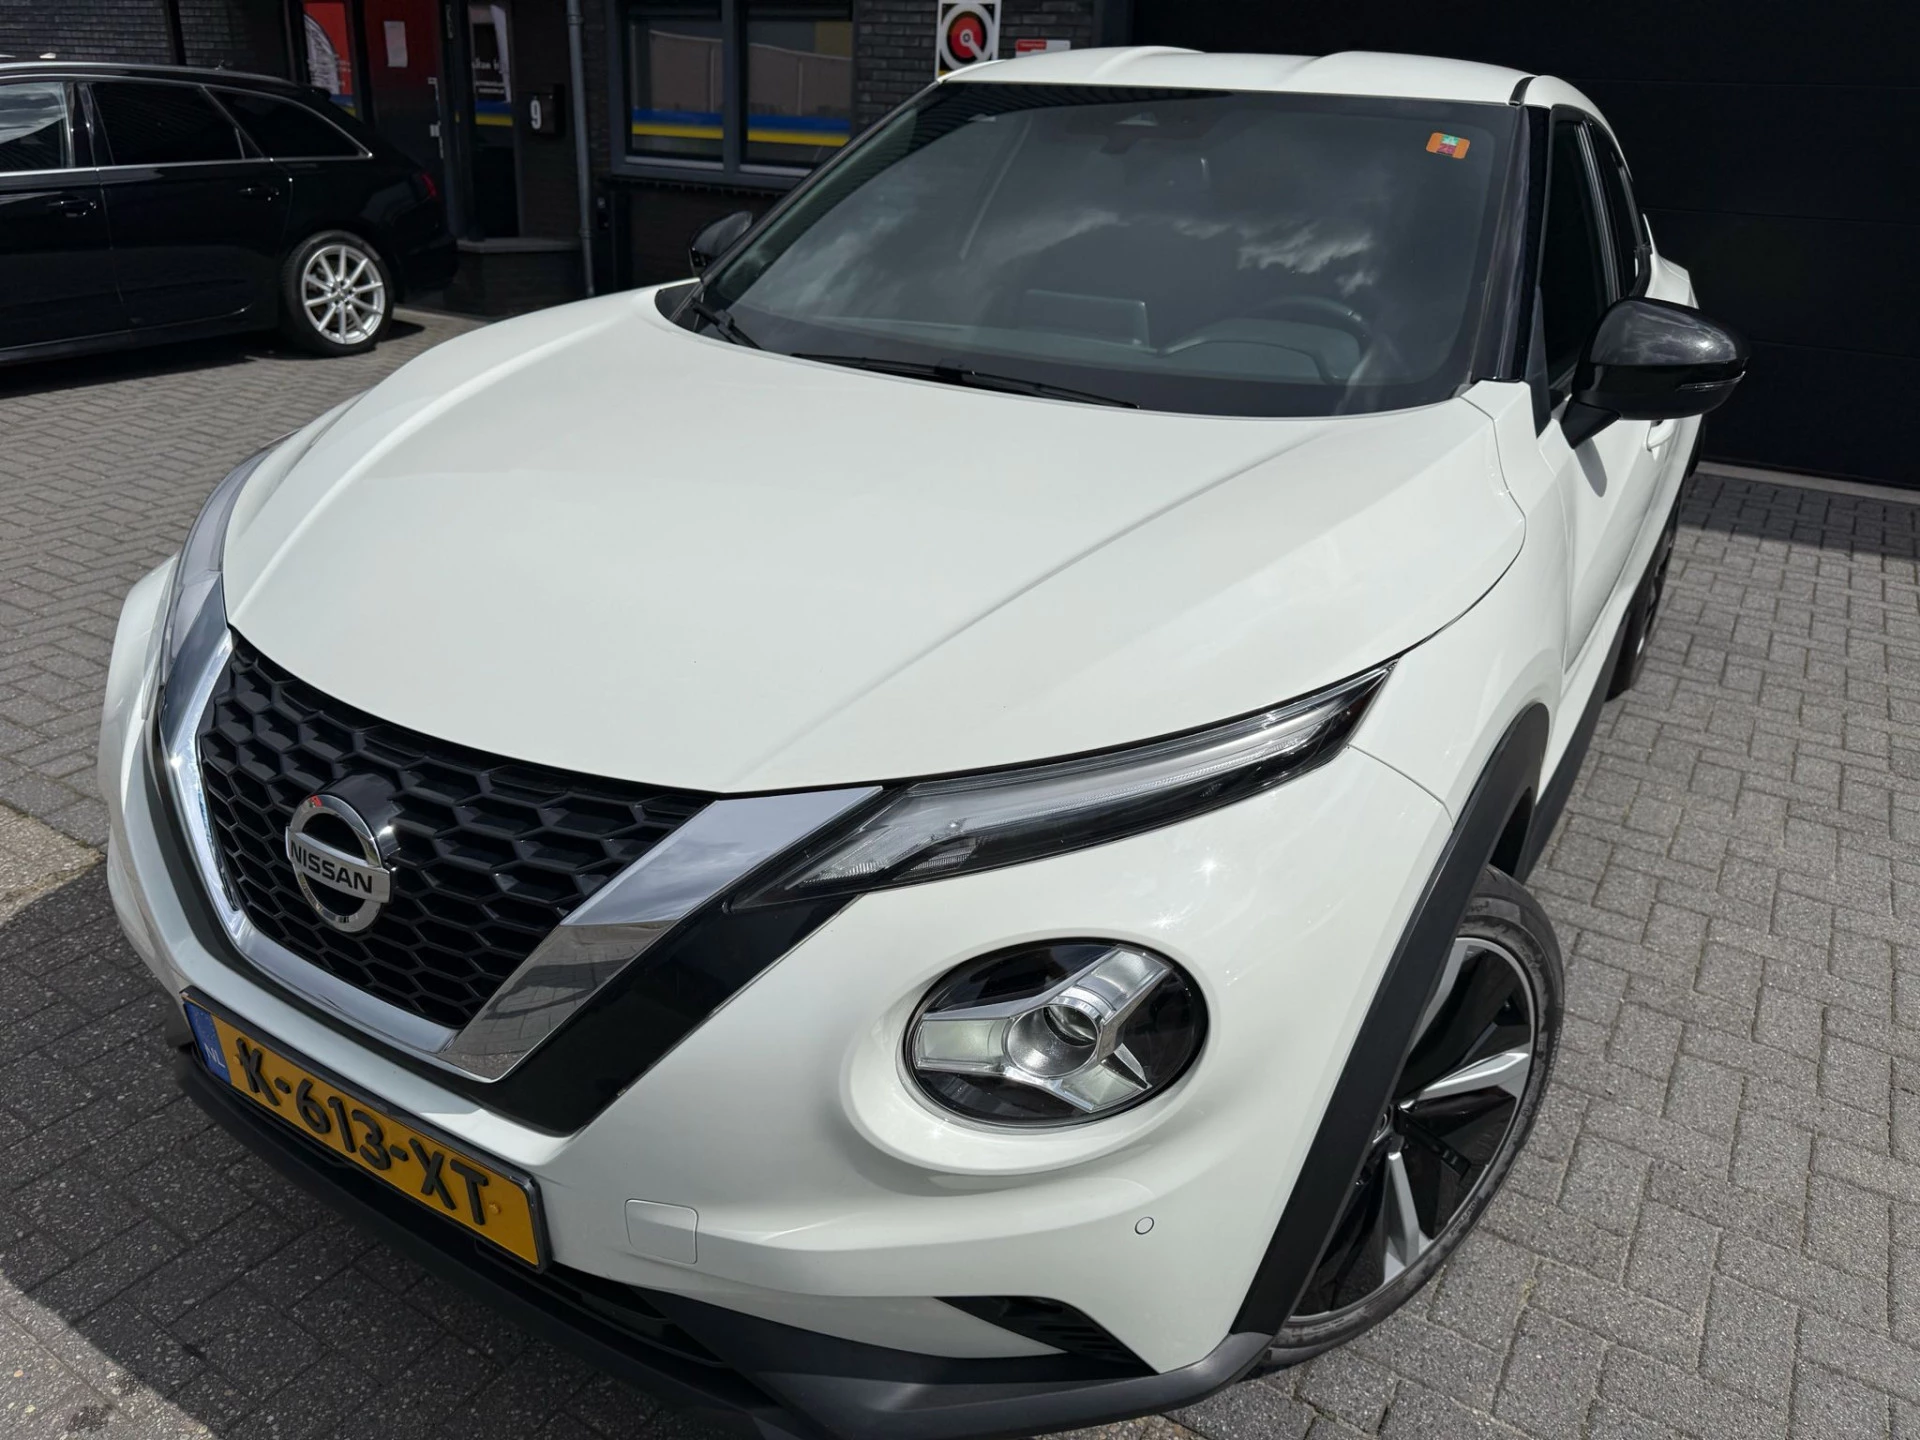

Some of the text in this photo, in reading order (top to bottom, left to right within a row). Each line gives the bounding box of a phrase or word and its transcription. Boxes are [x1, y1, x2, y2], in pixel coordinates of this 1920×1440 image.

[530, 99, 542, 129] 9
[290, 839, 373, 894] NISSAN
[203, 1043, 226, 1069] NL
[236, 1037, 489, 1226] K-613-XT
